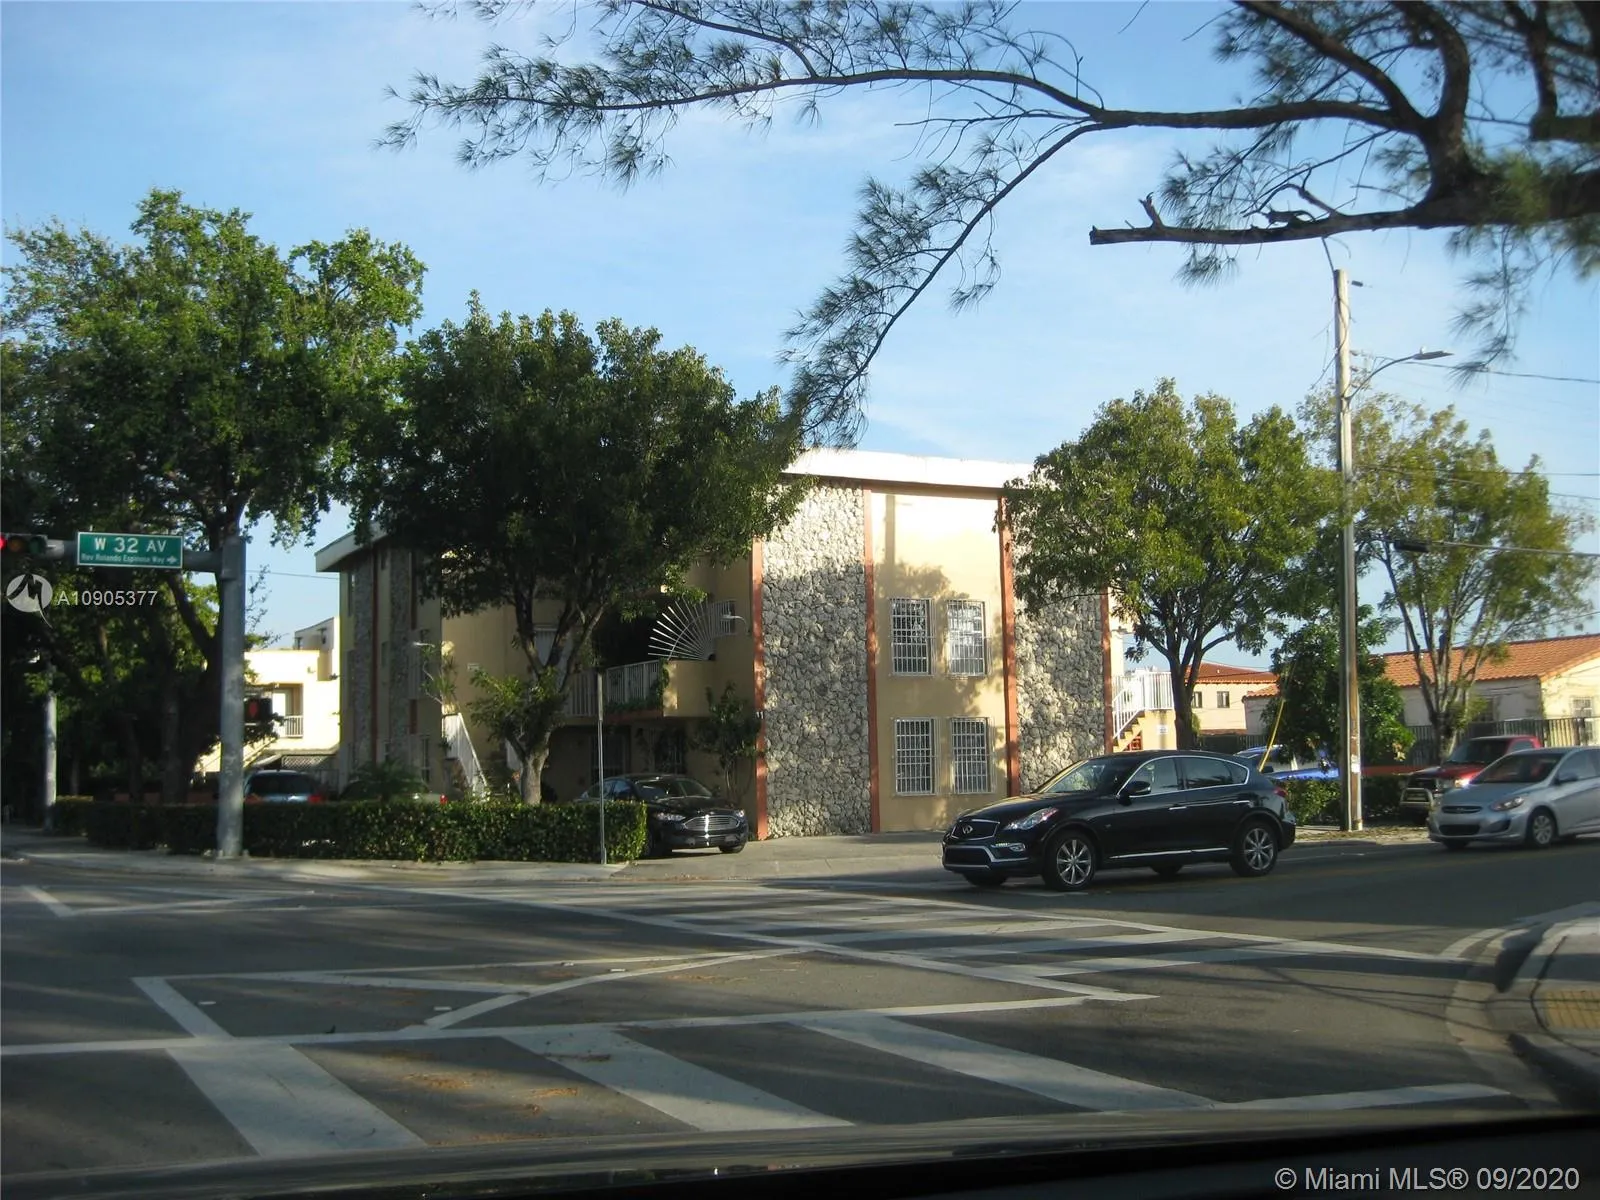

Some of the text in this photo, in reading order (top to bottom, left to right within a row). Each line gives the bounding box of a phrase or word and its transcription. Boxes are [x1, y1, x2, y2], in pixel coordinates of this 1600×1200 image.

[95, 537, 167, 553] W 32 AV
